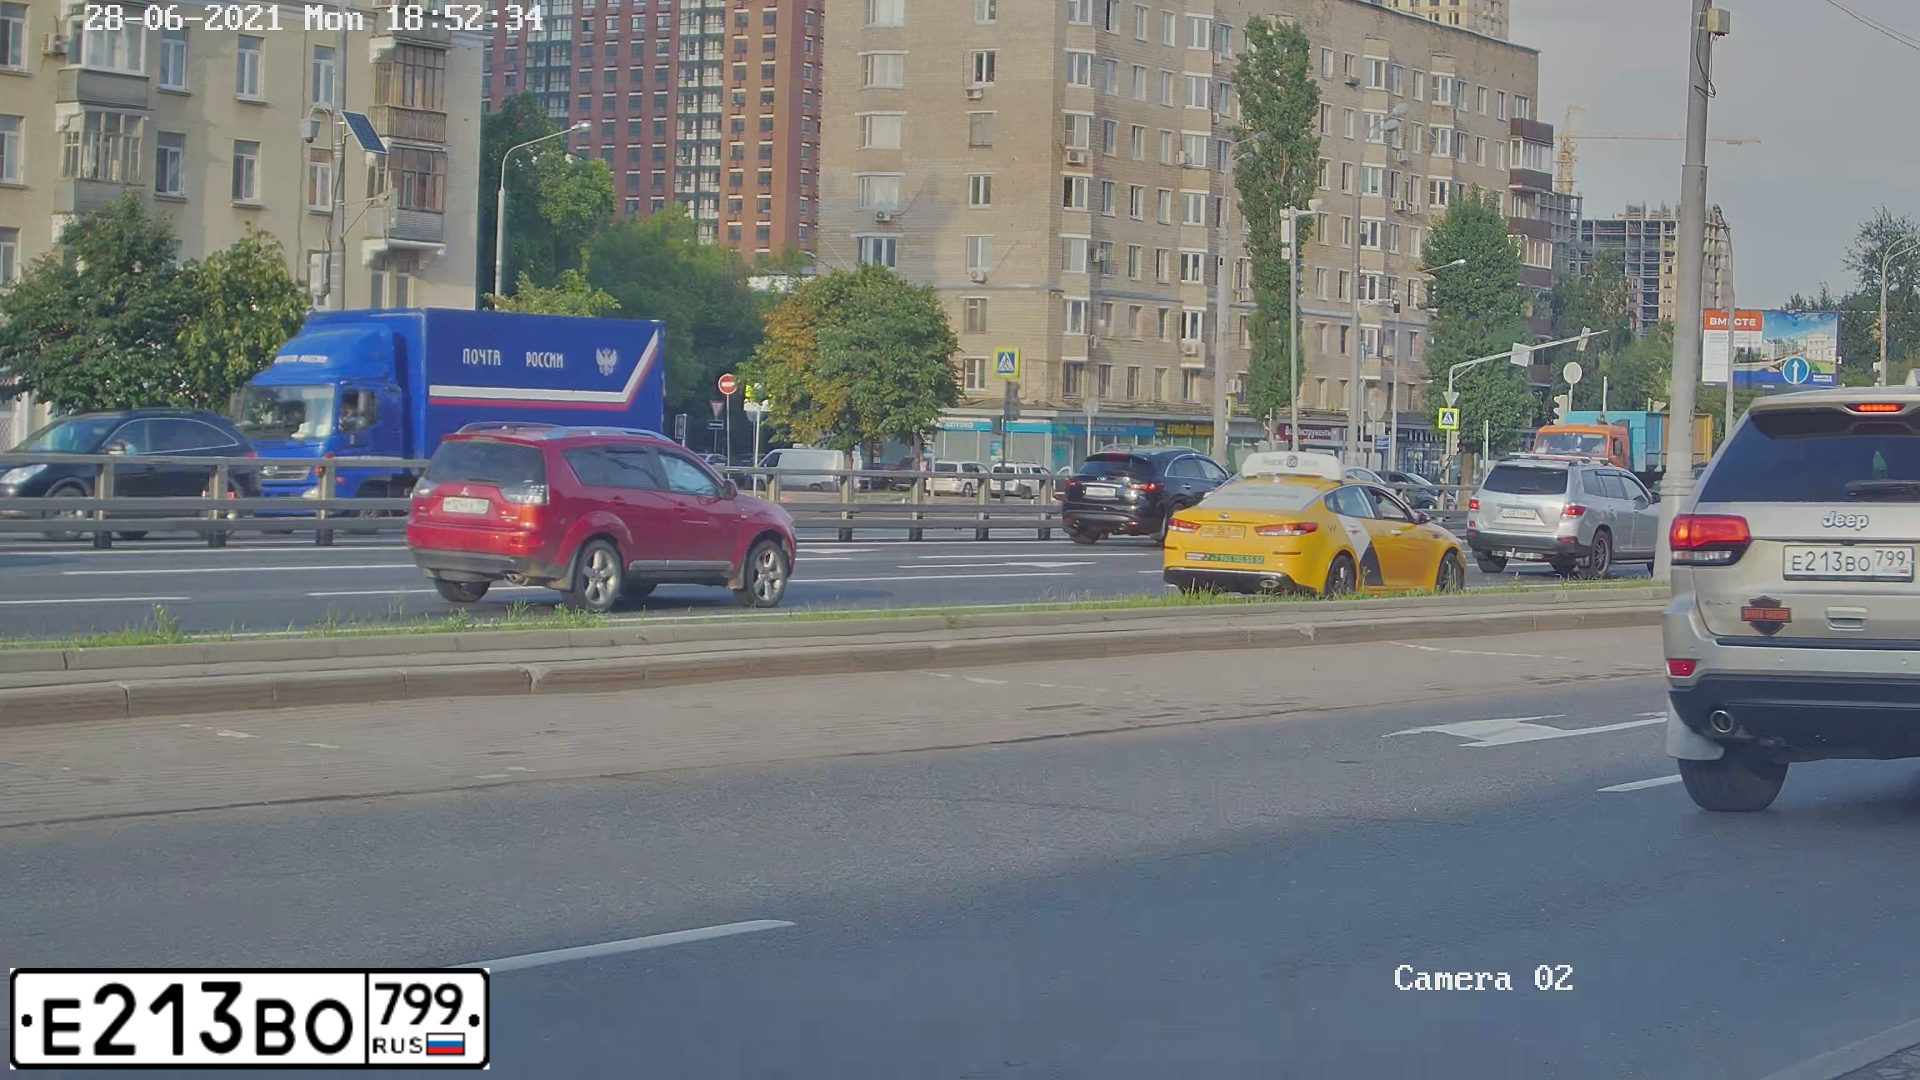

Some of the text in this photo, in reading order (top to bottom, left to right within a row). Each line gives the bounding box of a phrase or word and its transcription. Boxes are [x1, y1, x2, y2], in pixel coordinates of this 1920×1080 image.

[462, 348, 564, 369] ПОЧТА РОССИИ
[1822, 510, 1869, 530] Jeep
[1875, 550, 1906, 567] 799
